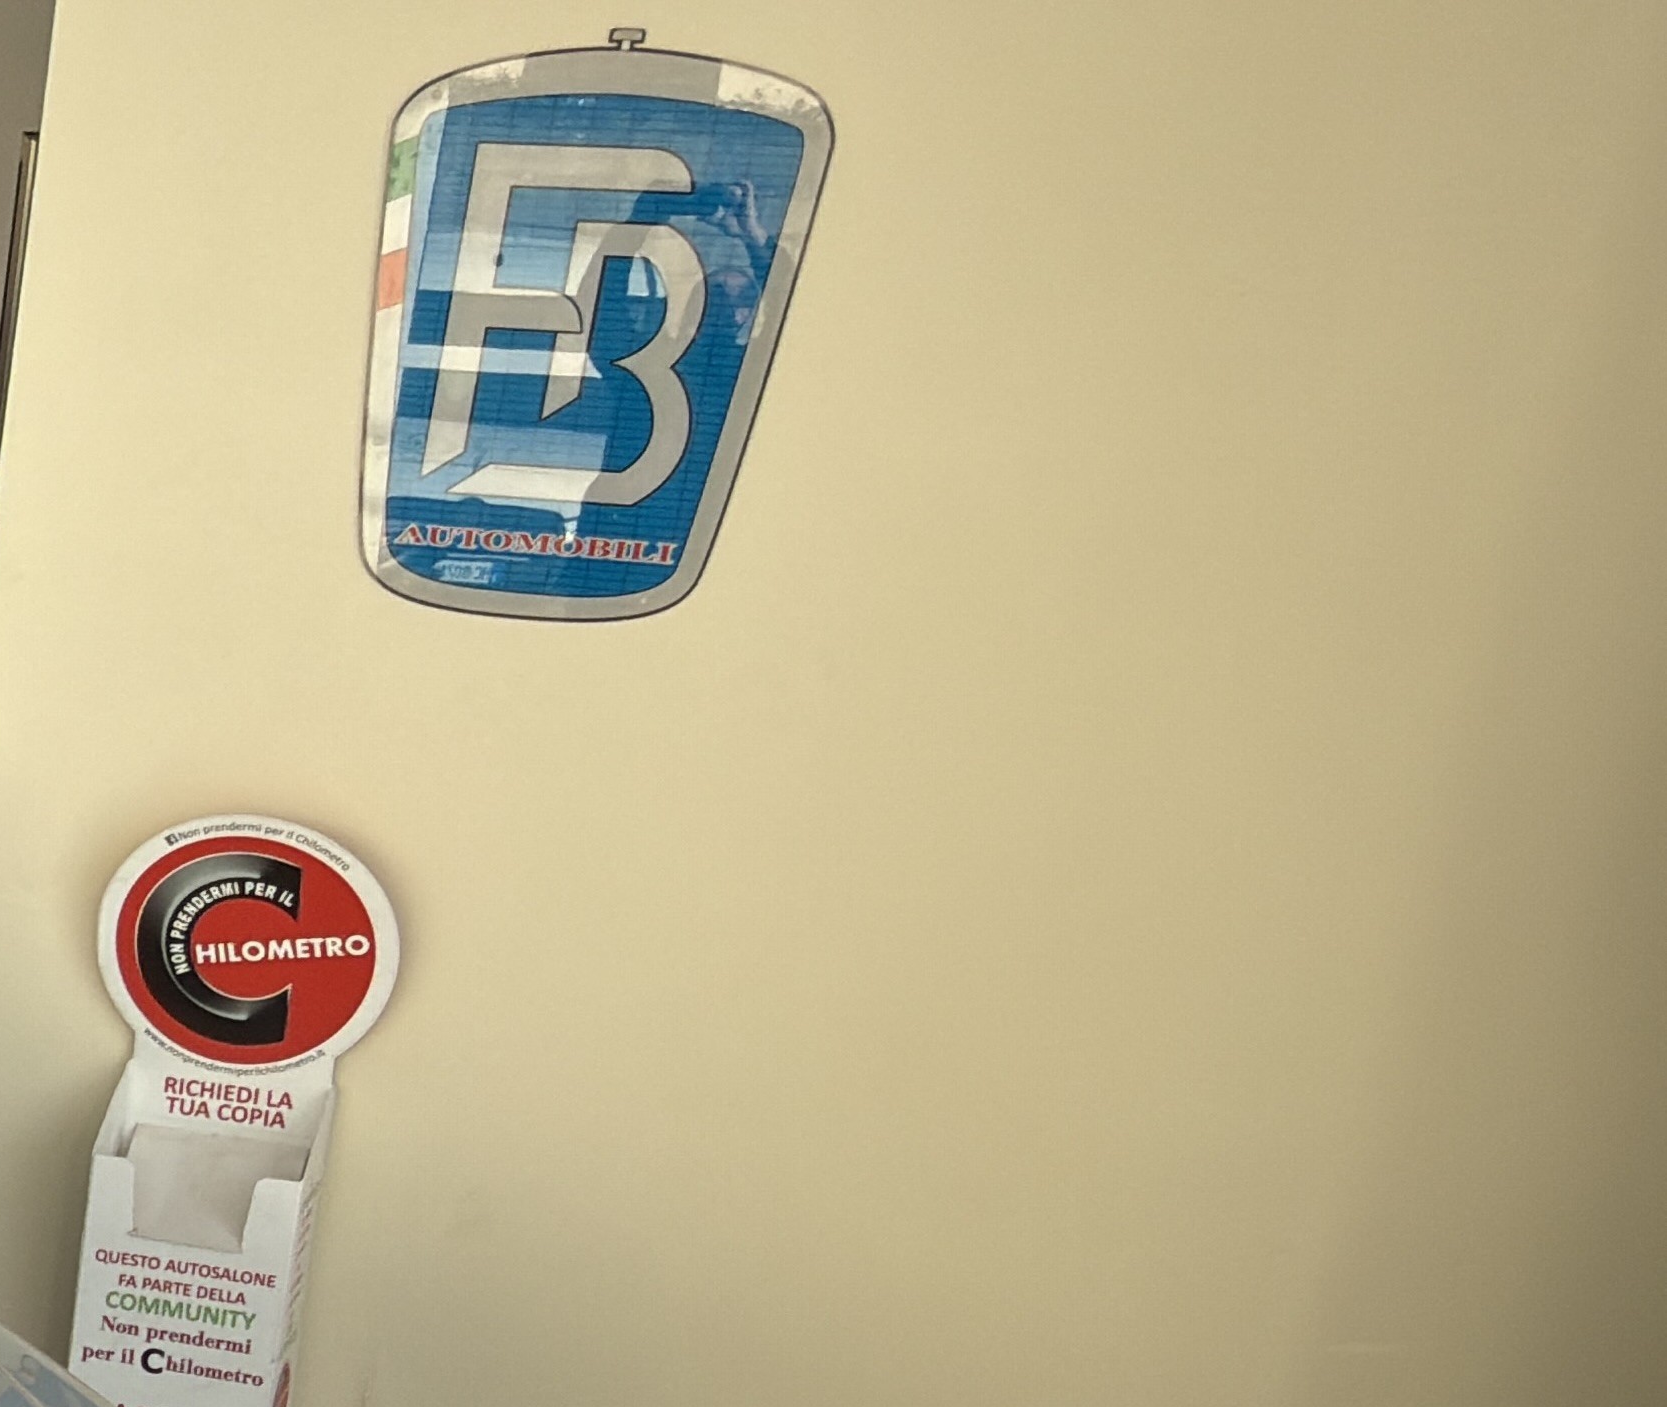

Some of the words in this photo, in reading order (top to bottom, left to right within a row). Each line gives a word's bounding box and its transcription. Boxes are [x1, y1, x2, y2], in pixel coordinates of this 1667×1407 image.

[393, 522, 679, 565] AUTOMOBILI
[178, 828, 201, 841] Non
[203, 822, 262, 835] prendermi
[264, 827, 283, 837] per
[296, 833, 351, 872] Chilometro
[244, 881, 277, 899] PER
[278, 890, 294, 907] IL
[170, 881, 240, 940] PRENDERMI
[169, 943, 191, 975] NON
[164, 1076, 260, 1105] RICHIEDI
[266, 1089, 293, 1110] LA
[166, 1097, 210, 1119] TUA
[216, 1103, 286, 1129] COPIA
[95, 1249, 161, 1270] QUESTO
[164, 1259, 277, 1288] AUTOSALONE
[118, 1273, 137, 1289] FA
[141, 1276, 191, 1297] PARTE
[196, 1286, 246, 1305] DELLA
[105, 1290, 257, 1331] COMMUNITY
[100, 1315, 140, 1336] Non
[145, 1325, 253, 1355] prendermi
[81, 1345, 115, 1363] per
[120, 1347, 135, 1365] il
[140, 1347, 265, 1387] Chilometro
